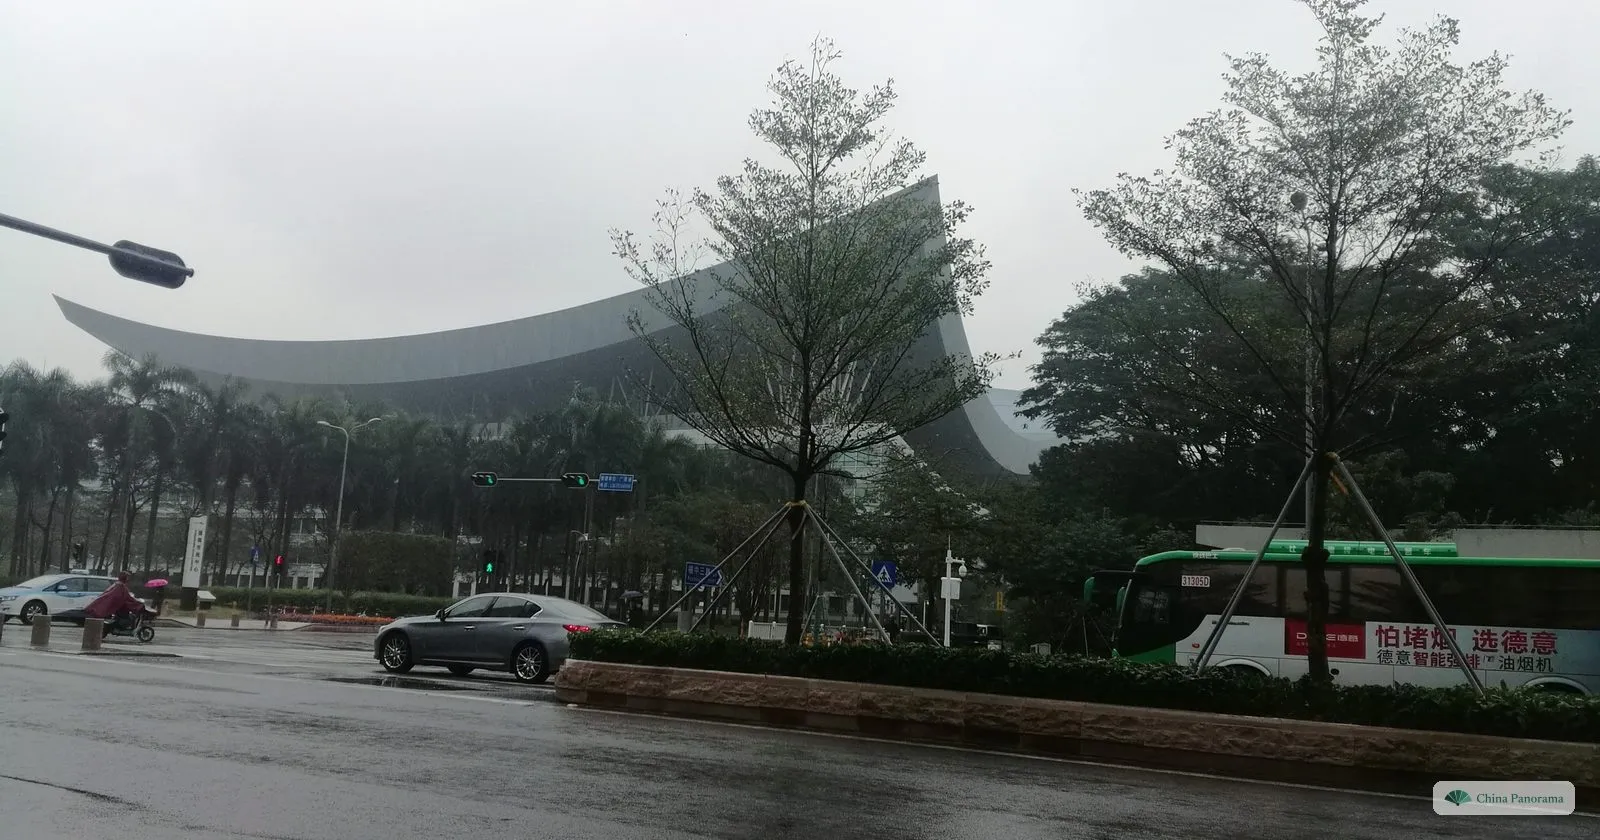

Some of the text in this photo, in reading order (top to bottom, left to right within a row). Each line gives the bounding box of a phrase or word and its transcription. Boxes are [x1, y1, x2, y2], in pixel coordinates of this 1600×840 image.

[1181, 576, 1210, 587] 31305D
[1375, 624, 1558, 655] 怕堵烟 选德意
[1498, 655, 1554, 673] 油烟机
